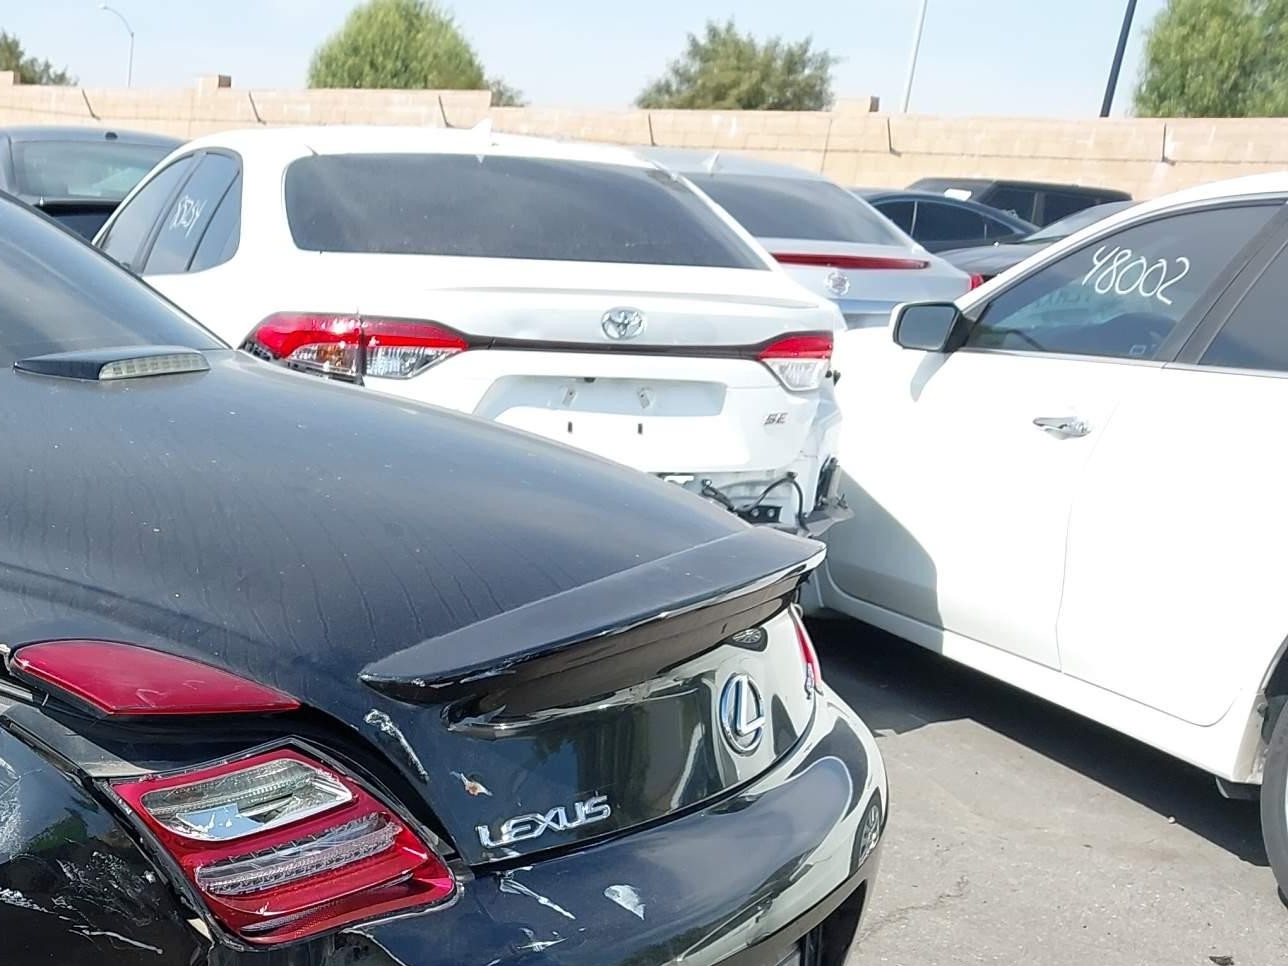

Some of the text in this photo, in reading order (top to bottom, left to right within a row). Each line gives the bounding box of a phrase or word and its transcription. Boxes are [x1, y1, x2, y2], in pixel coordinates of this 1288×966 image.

[1082, 245, 1191, 304] 48002
[763, 411, 788, 426] SE
[475, 794, 611, 848] LEXUS
